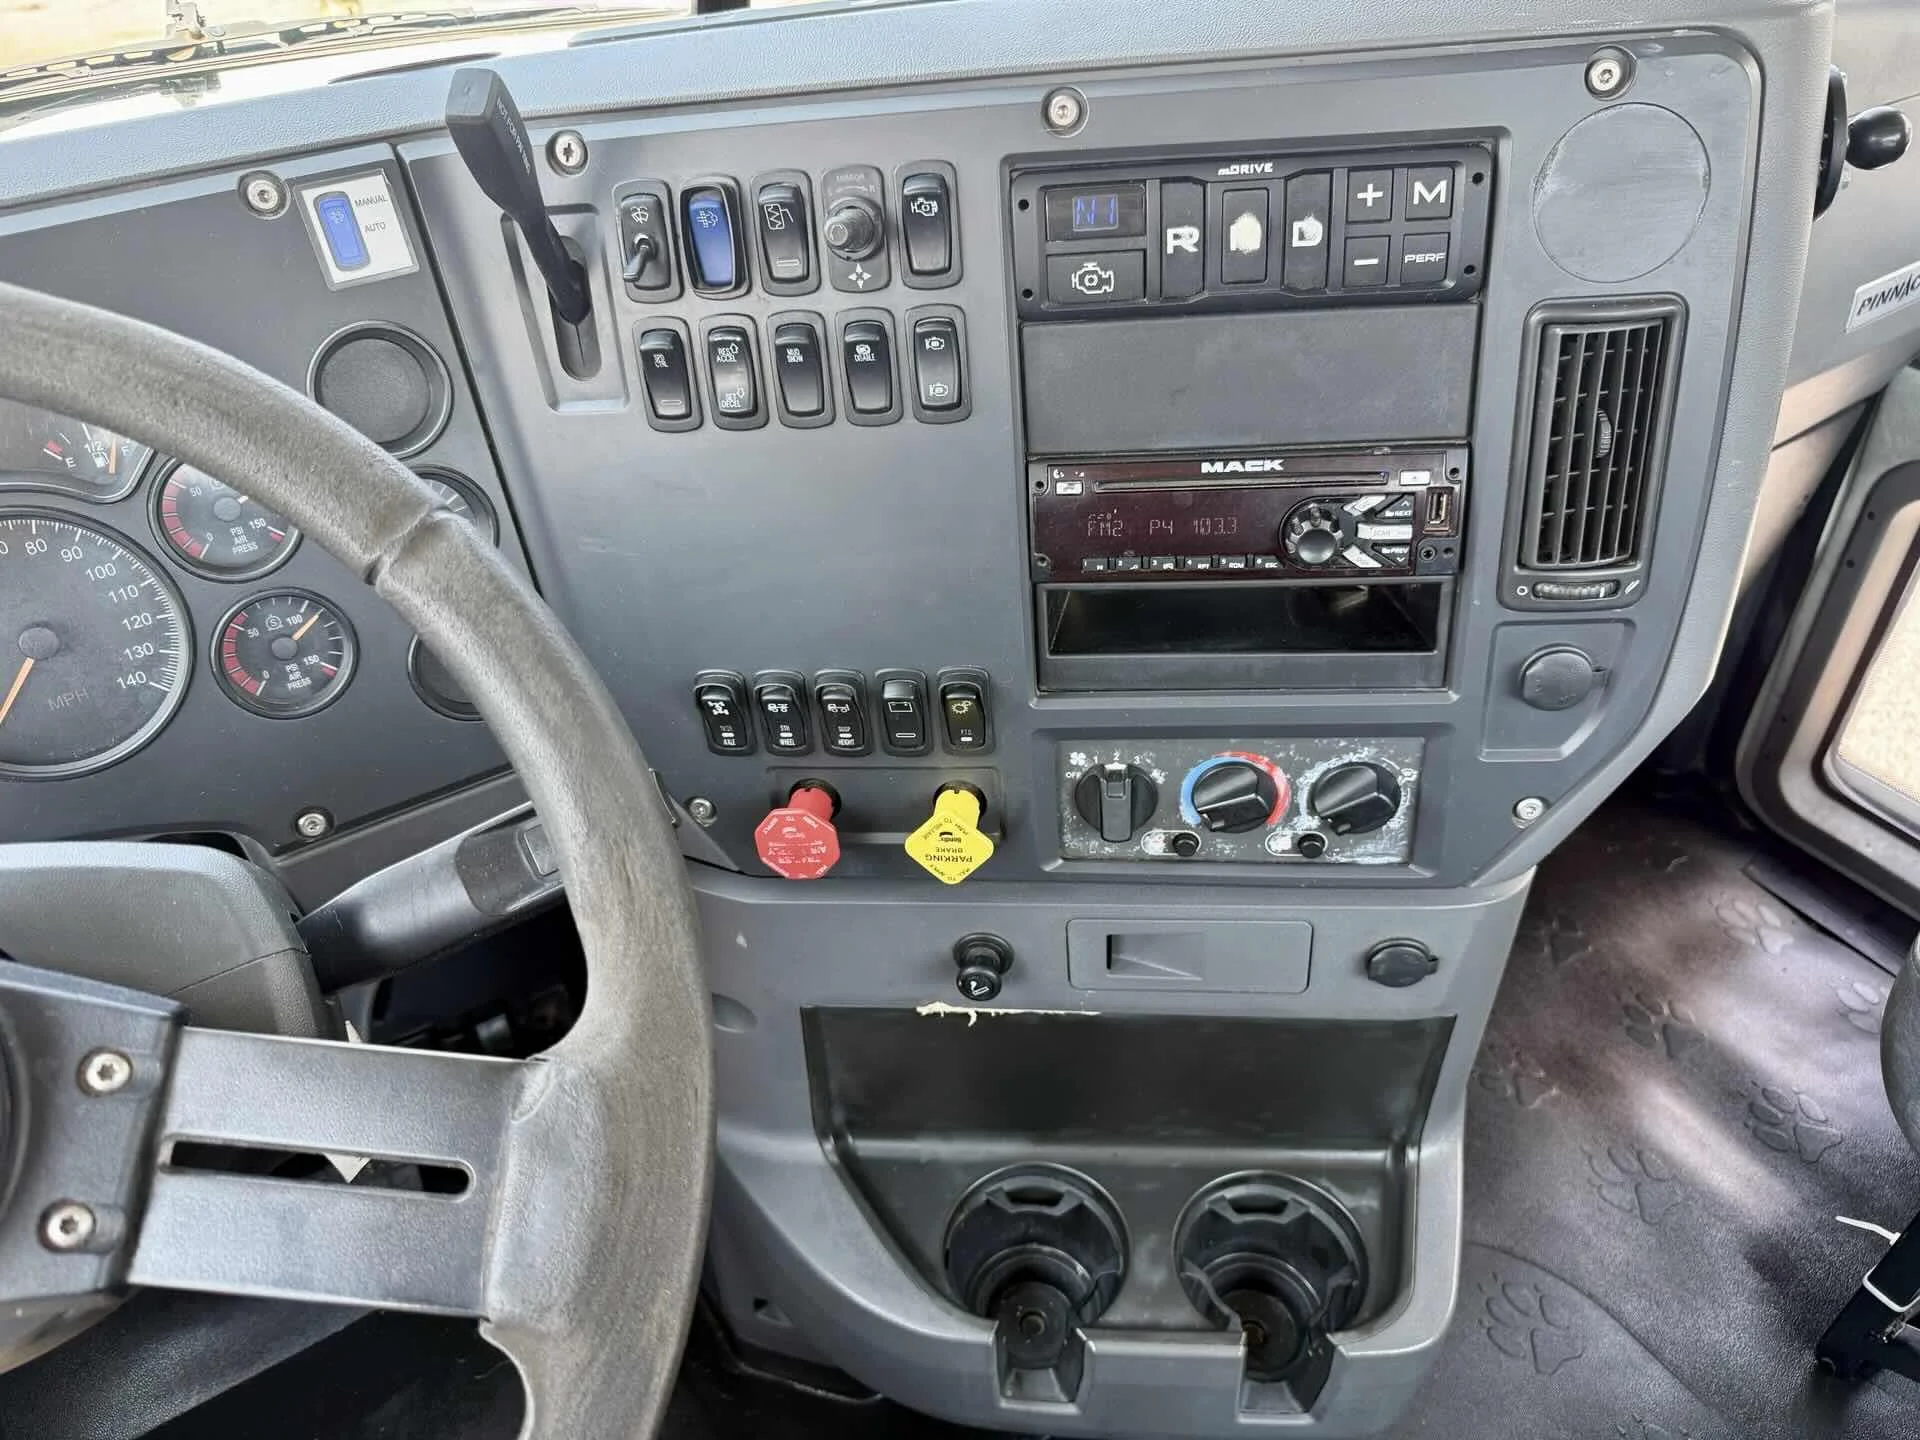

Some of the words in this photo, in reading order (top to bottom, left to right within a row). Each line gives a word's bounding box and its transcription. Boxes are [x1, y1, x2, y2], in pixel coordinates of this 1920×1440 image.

[1413, 180, 1447, 204] M
[354, 194, 388, 207] MANUAL
[364, 221, 386, 233] AUTO
[1292, 218, 1323, 247] D
[1166, 226, 1200, 254] R
[1404, 252, 1446, 264] PERF
[65, 457, 76, 469] E
[1201, 459, 1285, 474] MACK
[189, 487, 202, 497] 50
[250, 518, 266, 529] 150
[1150, 519, 1174, 535] P4
[206, 532, 214, 542] 0
[230, 526, 245, 536] PSI
[234, 535, 249, 545] AIR
[25, 538, 48, 556] 80
[231, 542, 259, 555] PRESS
[60, 545, 84, 563] 90
[86, 562, 117, 583] 100
[108, 584, 139, 605] 110
[121, 612, 152, 632] 120
[286, 614, 303, 627] 100
[247, 627, 260, 639] 50
[123, 643, 155, 662] 130
[303, 654, 320, 666] 150
[116, 671, 147, 690] 140
[262, 669, 271, 679] 0
[289, 671, 303, 681] AIR
[287, 677, 312, 691] PRESS
[48, 688, 90, 711] MPH
[1113, 751, 1120, 761] 2
[1134, 755, 1141, 765] 3
[1065, 771, 1082, 779] OFF
[924, 854, 973, 863] PARKING
